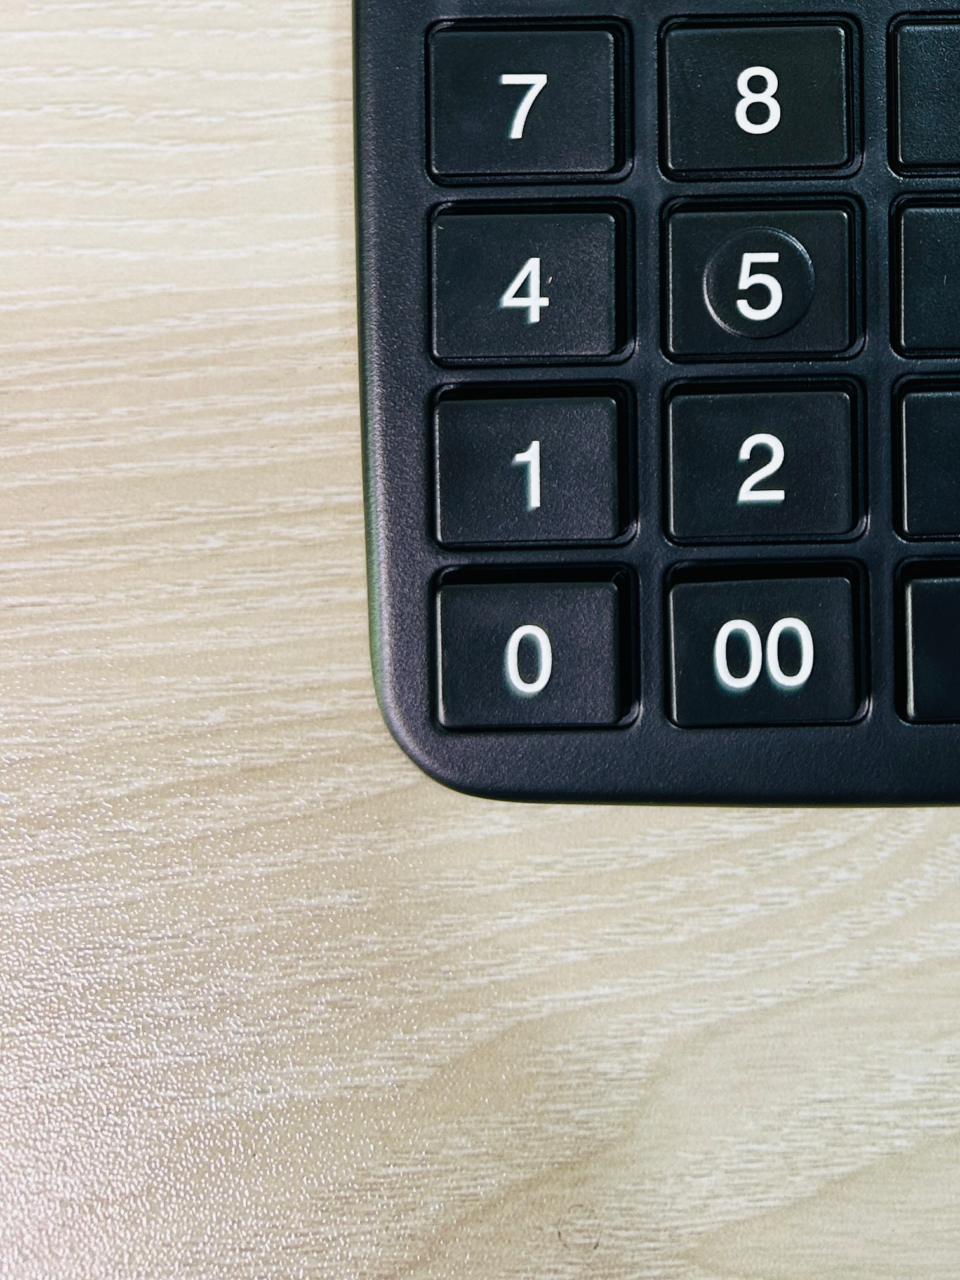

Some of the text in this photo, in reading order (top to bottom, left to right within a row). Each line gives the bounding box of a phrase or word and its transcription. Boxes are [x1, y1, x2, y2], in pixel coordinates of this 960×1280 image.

[501, 73, 548, 140] 7
[734, 66, 782, 135] 8
[500, 257, 550, 324] 4
[736, 251, 784, 321] 5
[512, 440, 542, 510] 1
[737, 433, 786, 502] 2
[505, 624, 553, 695] 0
[713, 617, 815, 690] 00
